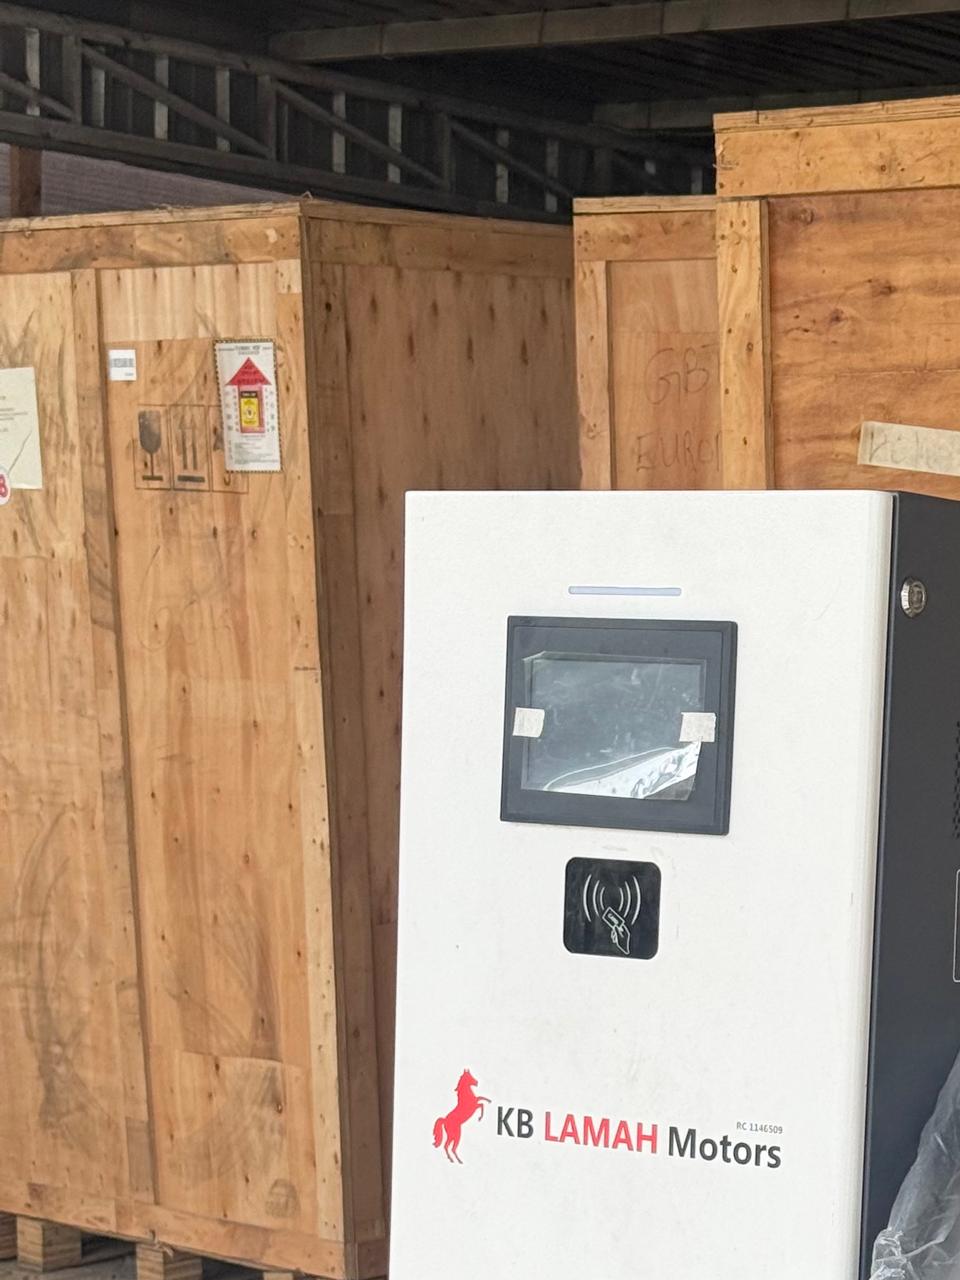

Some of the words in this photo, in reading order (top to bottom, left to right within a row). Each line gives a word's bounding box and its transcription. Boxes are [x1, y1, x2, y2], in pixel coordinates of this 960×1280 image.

[496, 1105, 534, 1139] KB
[544, 1111, 658, 1154] LAMAH
[667, 1126, 782, 1169] Motors
[736, 1121, 748, 1132] RC
[749, 1123, 784, 1135] 1146509
